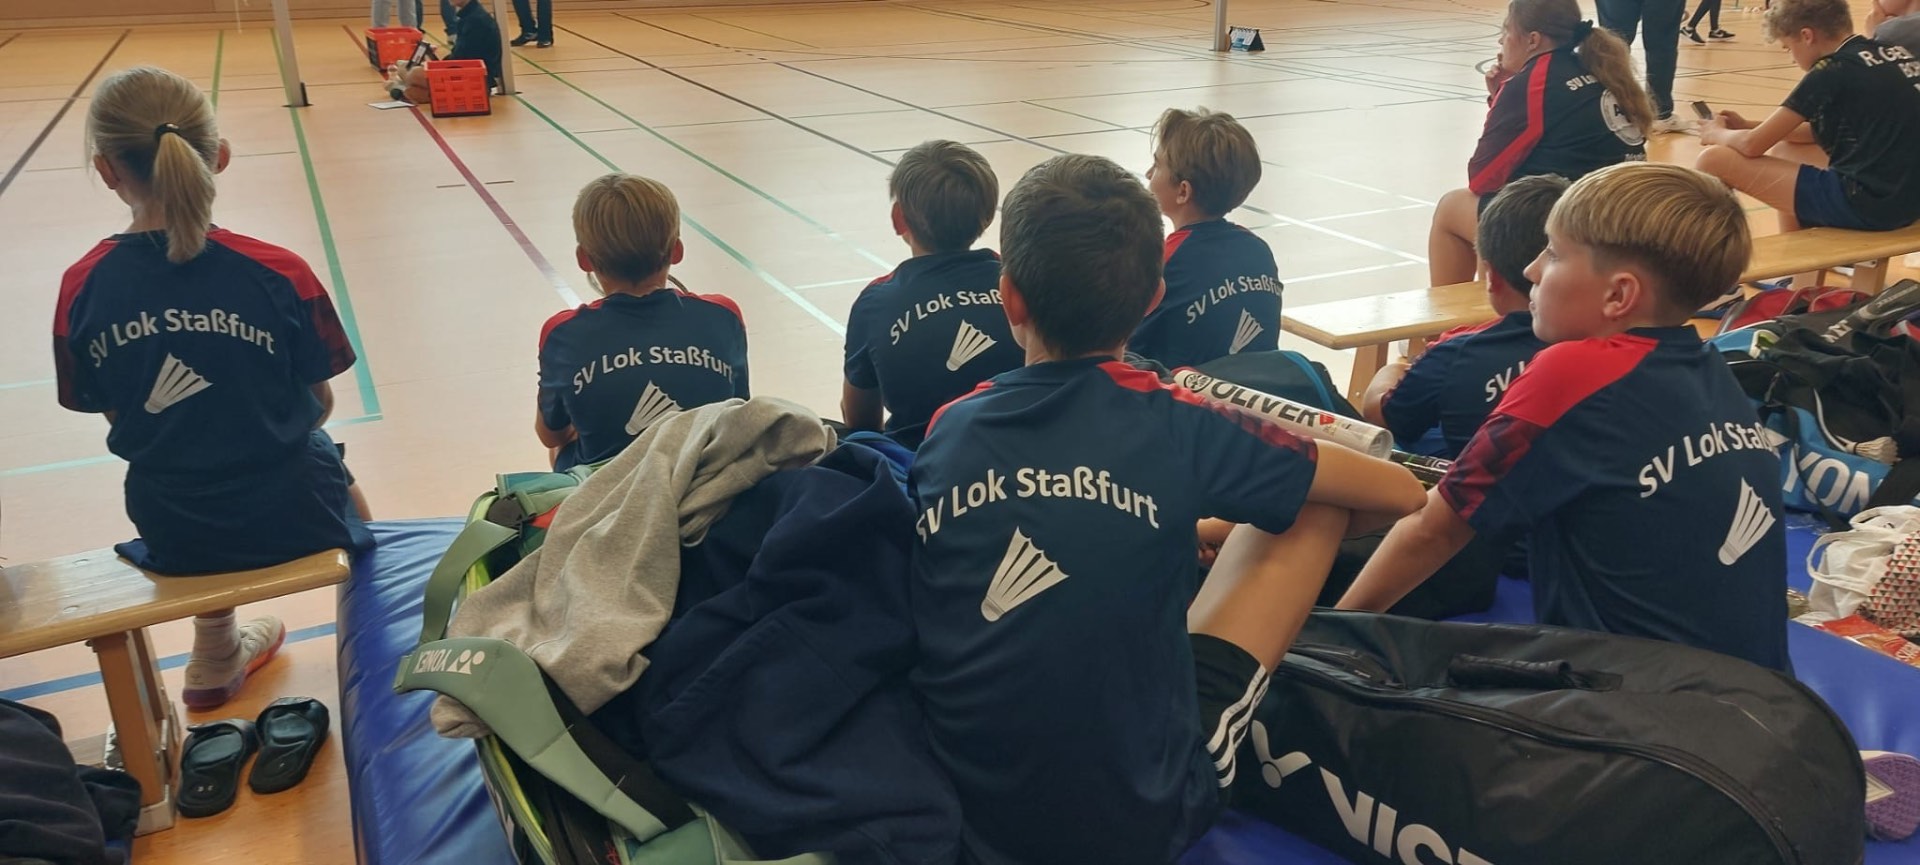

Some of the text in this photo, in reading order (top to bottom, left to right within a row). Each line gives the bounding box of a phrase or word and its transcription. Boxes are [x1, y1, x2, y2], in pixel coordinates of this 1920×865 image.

[1566, 76, 1584, 91] SV
[889, 310, 911, 346] SV
[914, 293, 954, 320] Lok
[1186, 294, 1206, 325] SV
[1209, 278, 1238, 305] Lok
[89, 308, 275, 368] SV Lok Staßfurt
[572, 360, 596, 396] SV
[602, 347, 643, 374] Lok
[1484, 366, 1513, 403] SV
[1211, 380, 1320, 427] OLIVER
[1638, 445, 1675, 499] SV
[1682, 422, 1730, 467] Lok
[915, 465, 1160, 545] SV Lok Staßfurt
[412, 648, 453, 675] YONEX
